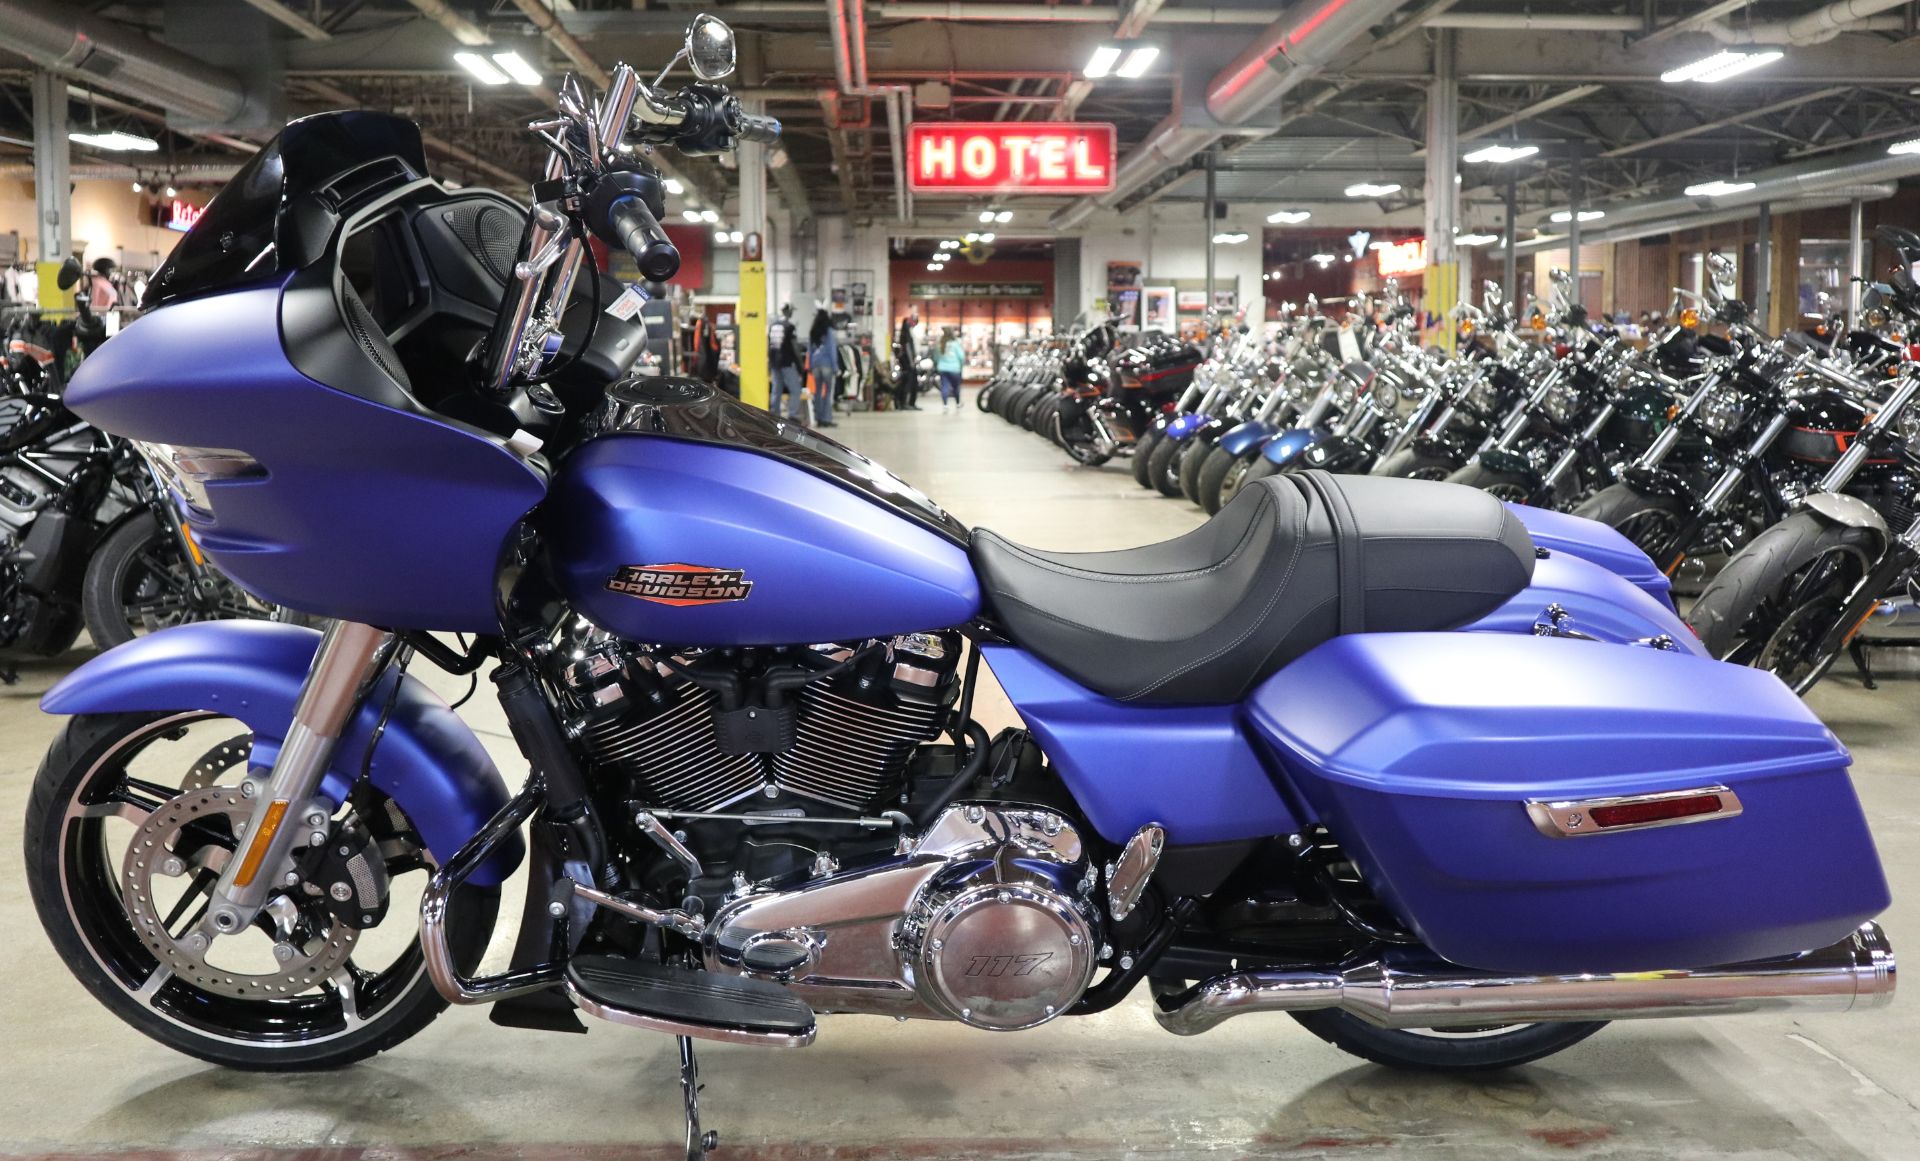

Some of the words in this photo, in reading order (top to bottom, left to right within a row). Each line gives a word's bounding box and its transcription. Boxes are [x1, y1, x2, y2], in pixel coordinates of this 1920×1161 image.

[921, 135, 1105, 179] HOTEL
[608, 580, 746, 598] DAVIDSON
[965, 952, 1054, 977] 117
